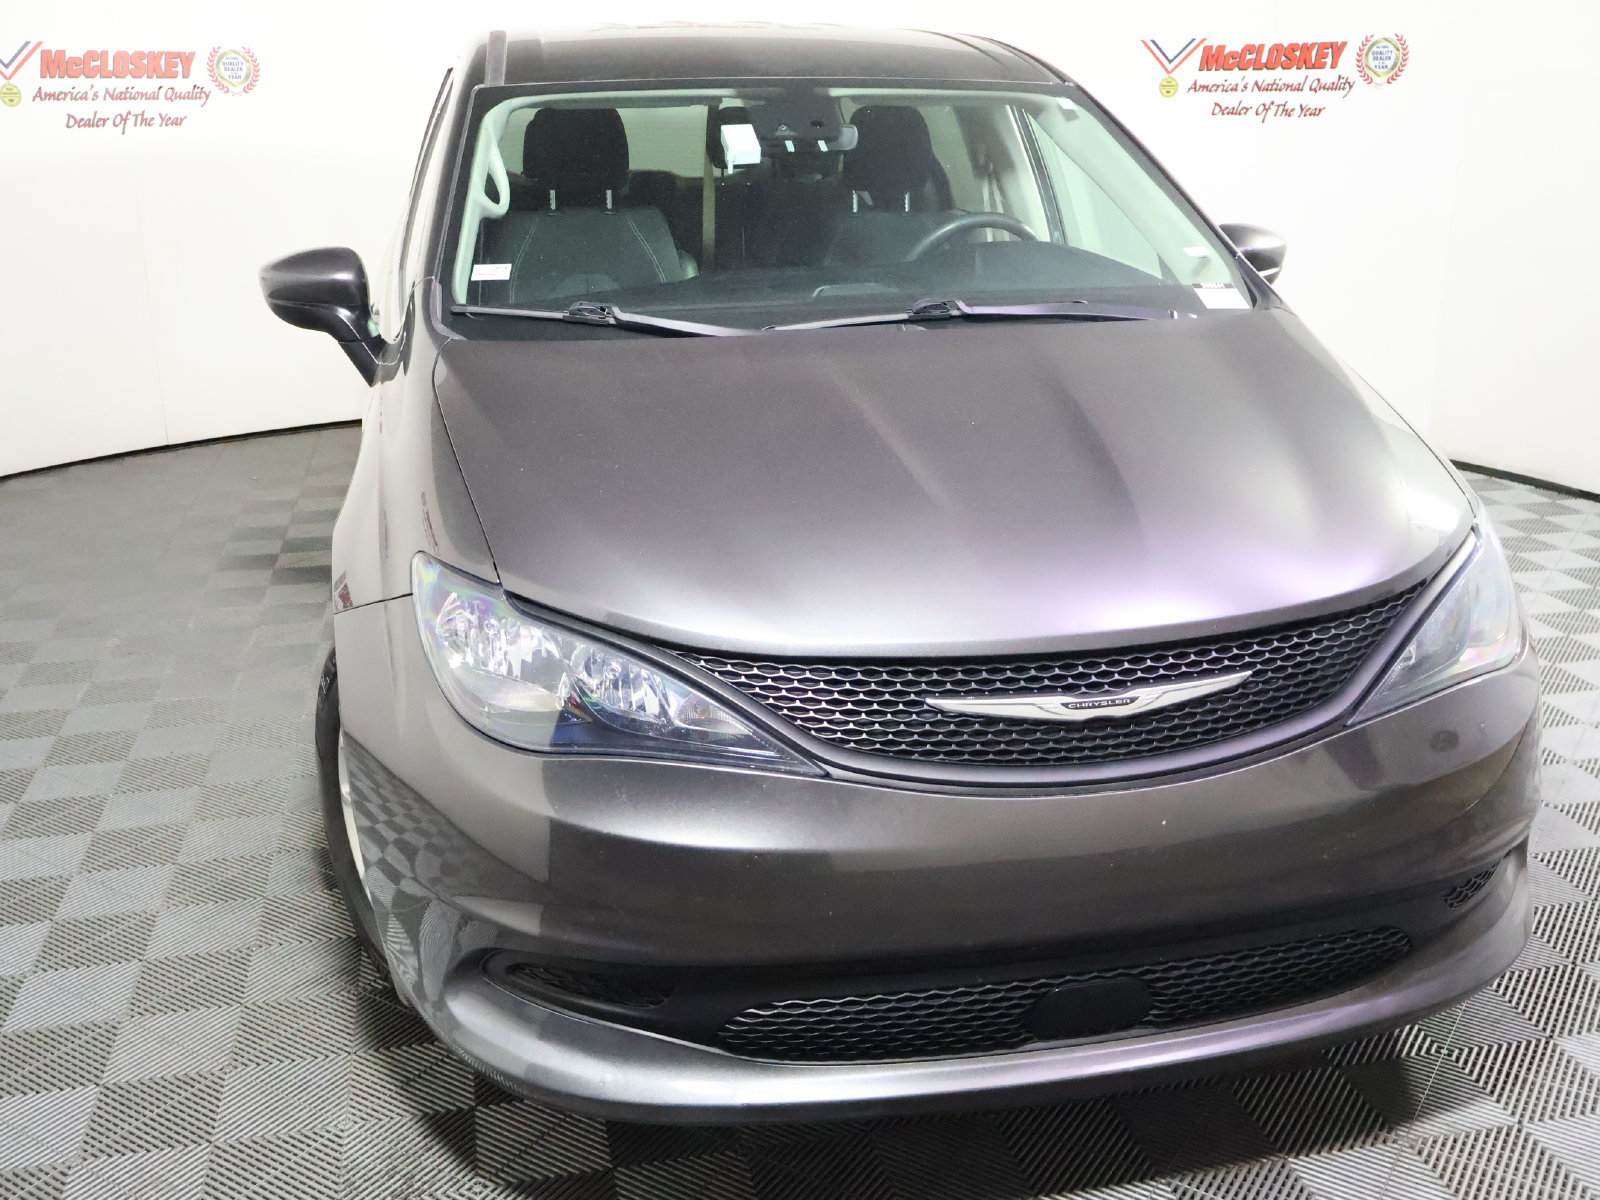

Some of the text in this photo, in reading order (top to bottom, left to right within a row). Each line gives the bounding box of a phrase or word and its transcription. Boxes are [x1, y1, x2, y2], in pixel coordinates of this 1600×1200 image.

[40, 49, 195, 79] McCLOSKEY
[1199, 41, 1348, 72] McCLOSKEY
[32, 84, 99, 103] America's
[103, 85, 163, 102] National
[164, 84, 211, 107] Quality
[1187, 76, 1248, 93] America's
[1251, 75, 1306, 93] National
[1309, 75, 1356, 98] Quality
[65, 110, 187, 134] Dealer Of The Year
[1211, 101, 1326, 123] Dealer Of The Year
[1068, 699, 1131, 708] CHRYSLER
